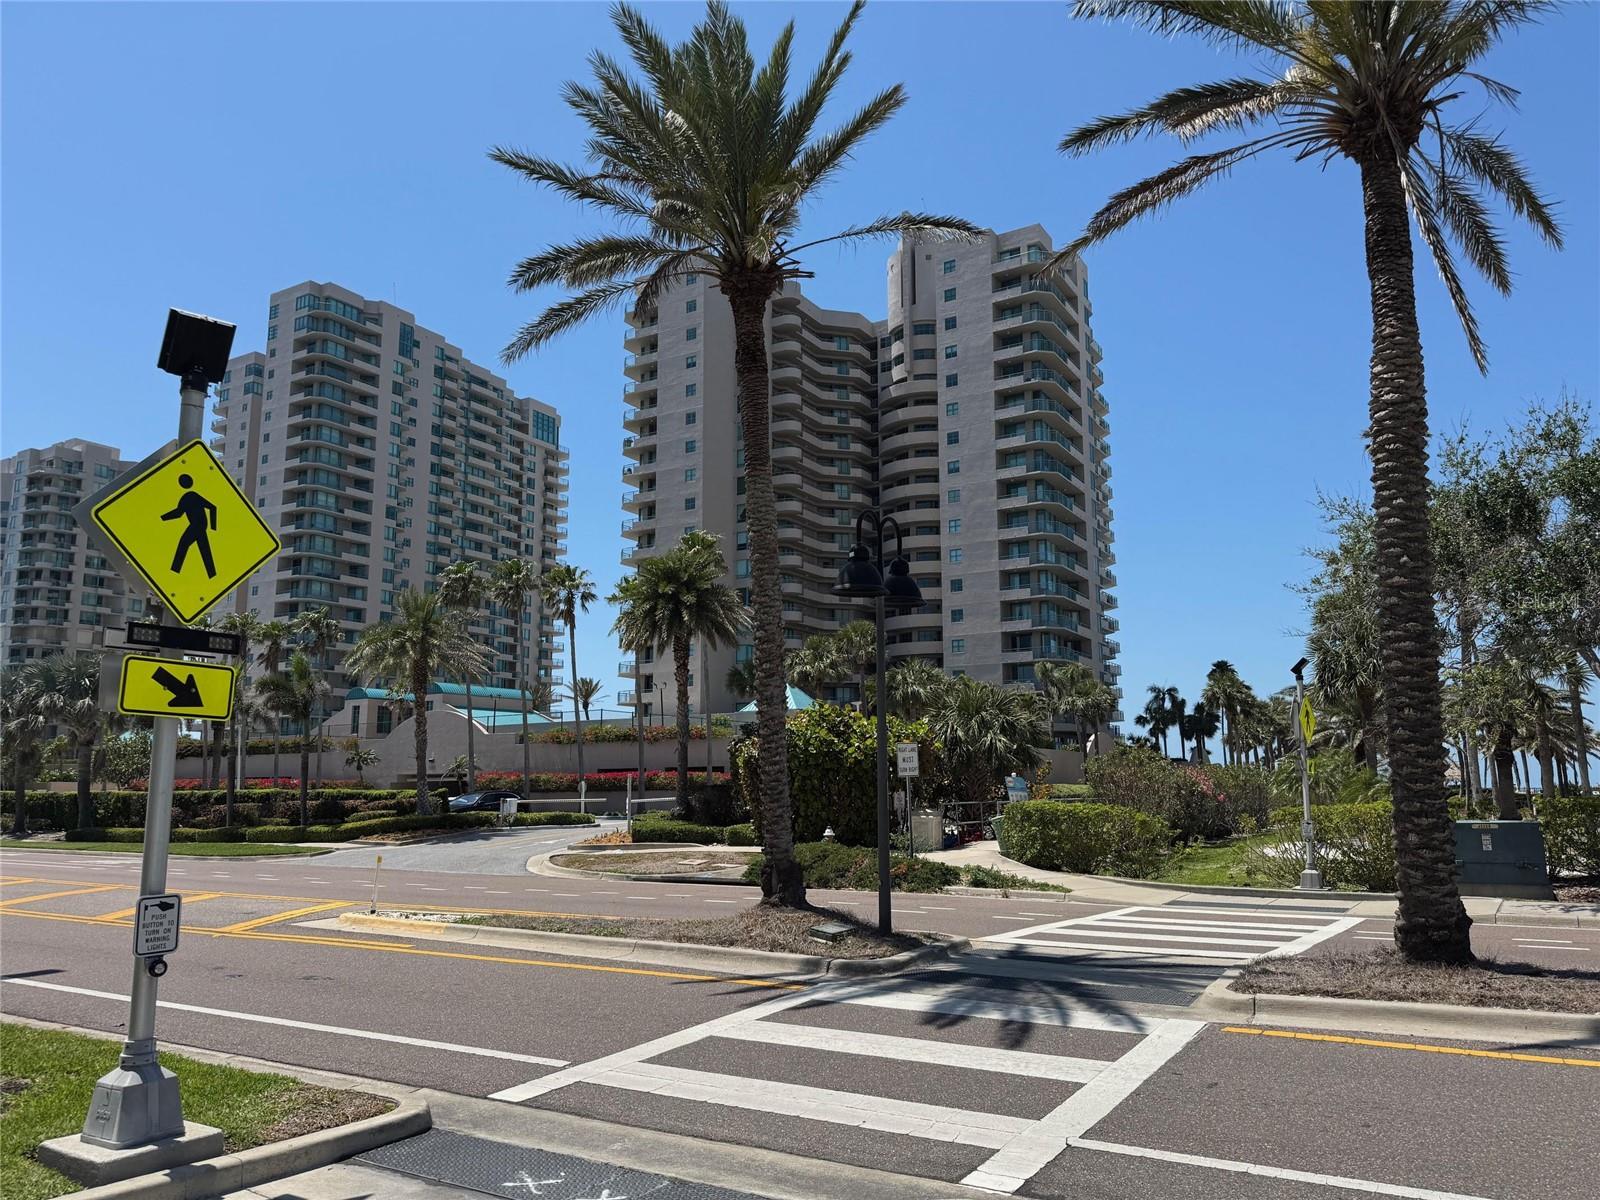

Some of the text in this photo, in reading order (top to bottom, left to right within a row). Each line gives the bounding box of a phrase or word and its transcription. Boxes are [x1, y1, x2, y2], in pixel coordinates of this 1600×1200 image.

[151, 913, 167, 921] PUSH
[142, 921, 164, 929] BUTTON
[145, 928, 160, 936] TURN
[145, 934, 170, 943] WARNING
[147, 942, 167, 951] LIGHTS
